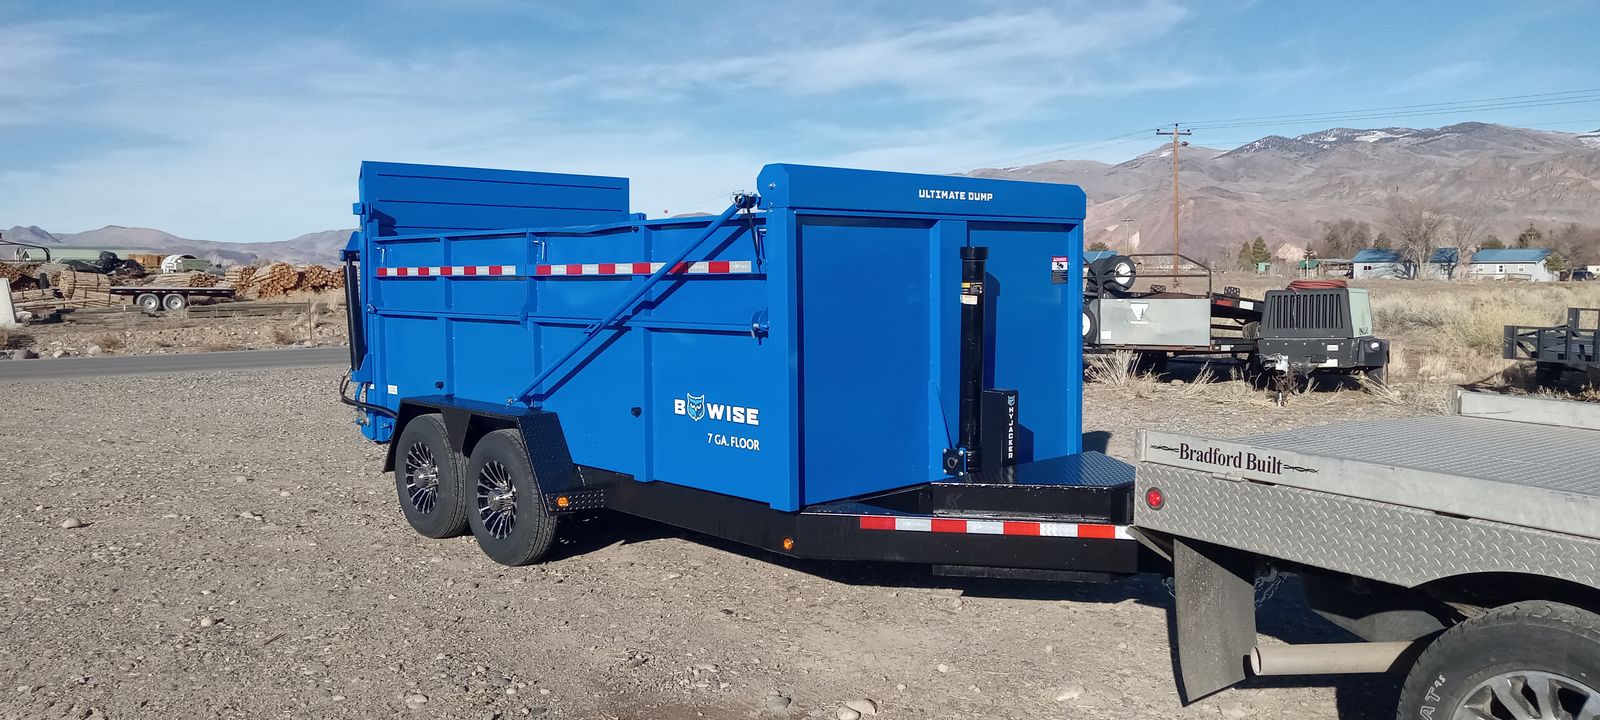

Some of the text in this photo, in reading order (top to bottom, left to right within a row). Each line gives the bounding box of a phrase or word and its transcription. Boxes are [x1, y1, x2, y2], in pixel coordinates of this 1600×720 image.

[919, 189, 993, 201] ULTIMATE DUMP
[707, 433, 760, 451] 7 GA. FLOOR
[1179, 442, 1283, 475] Bradford Built
